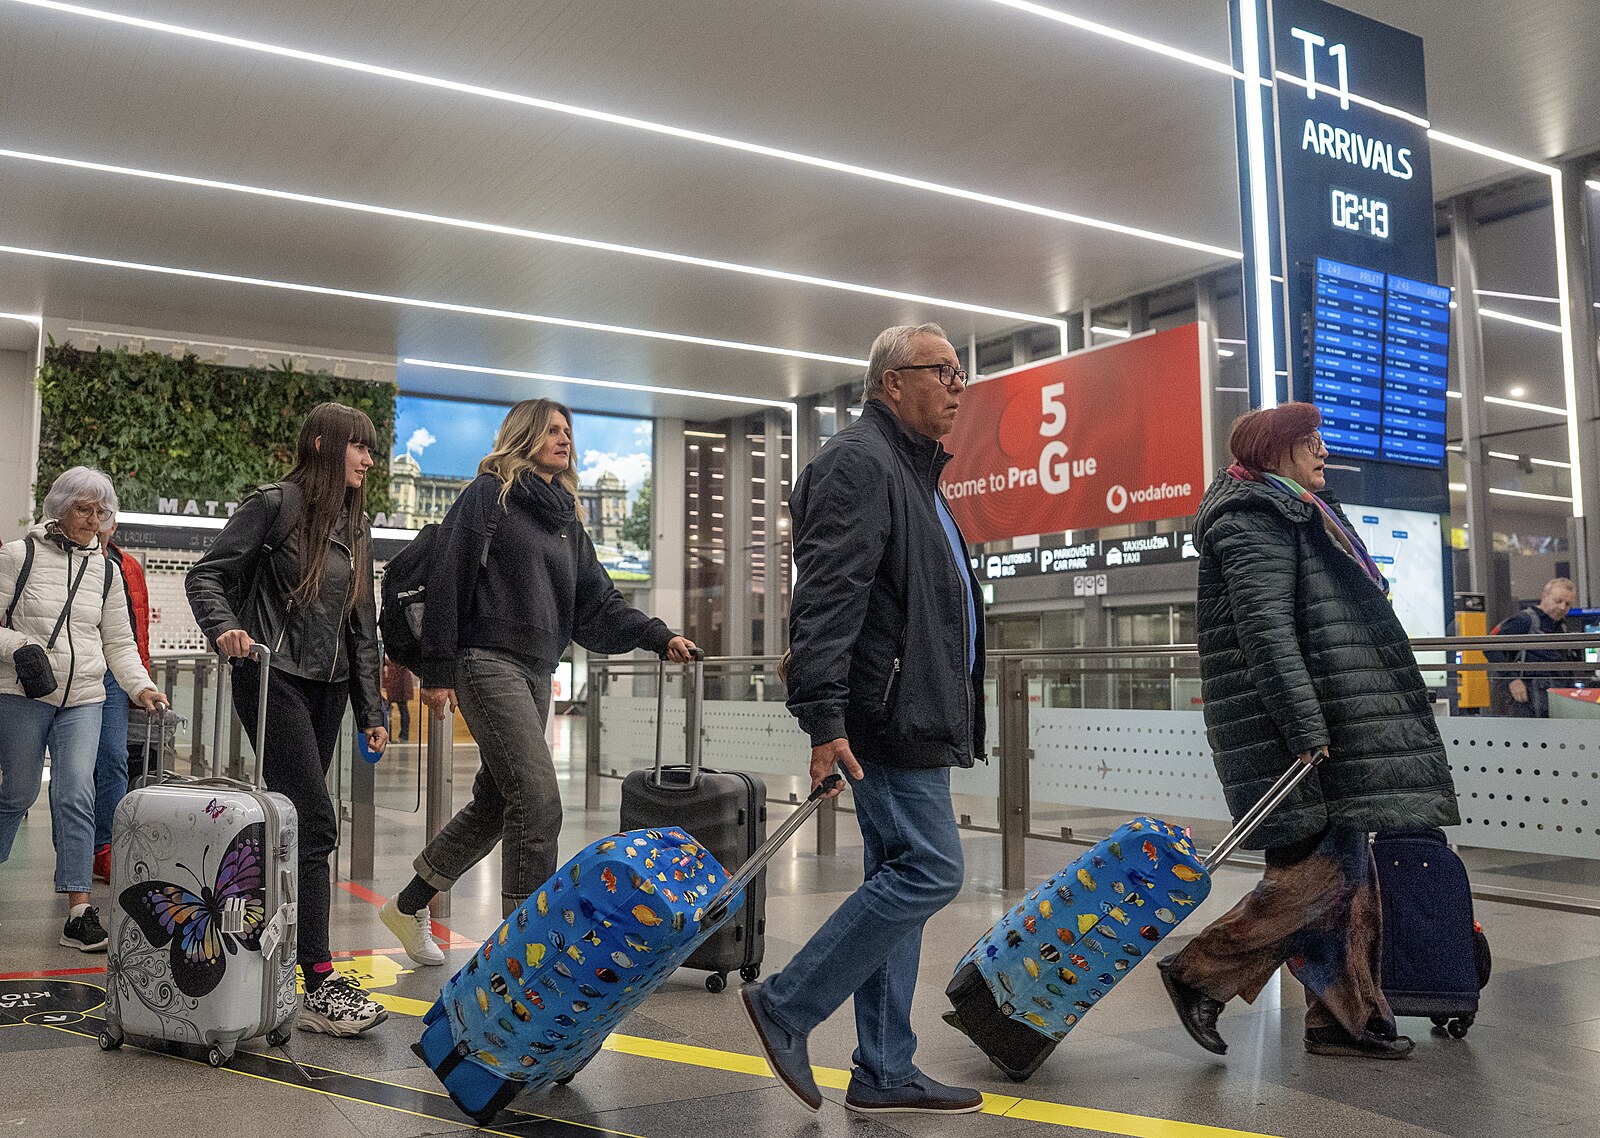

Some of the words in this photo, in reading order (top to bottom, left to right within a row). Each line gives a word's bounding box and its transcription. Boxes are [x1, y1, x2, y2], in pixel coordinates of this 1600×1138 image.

[1291, 27, 1349, 110] T1
[1302, 119, 1413, 180] ARRIVALS
[1332, 190, 1389, 238] 02:43
[1039, 382, 1067, 437] 5
[989, 473, 1006, 492] to
[1129, 482, 1191, 503] vodafone
[1122, 536, 1169, 552] TAXISLUŽBA
[1002, 552, 1032, 565] AUTOBUS
[1053, 559, 1068, 571] CAR
[1069, 557, 1088, 569] PARK
[1123, 552, 1141, 564] TAXI
[1002, 565, 1016, 576] BUS
